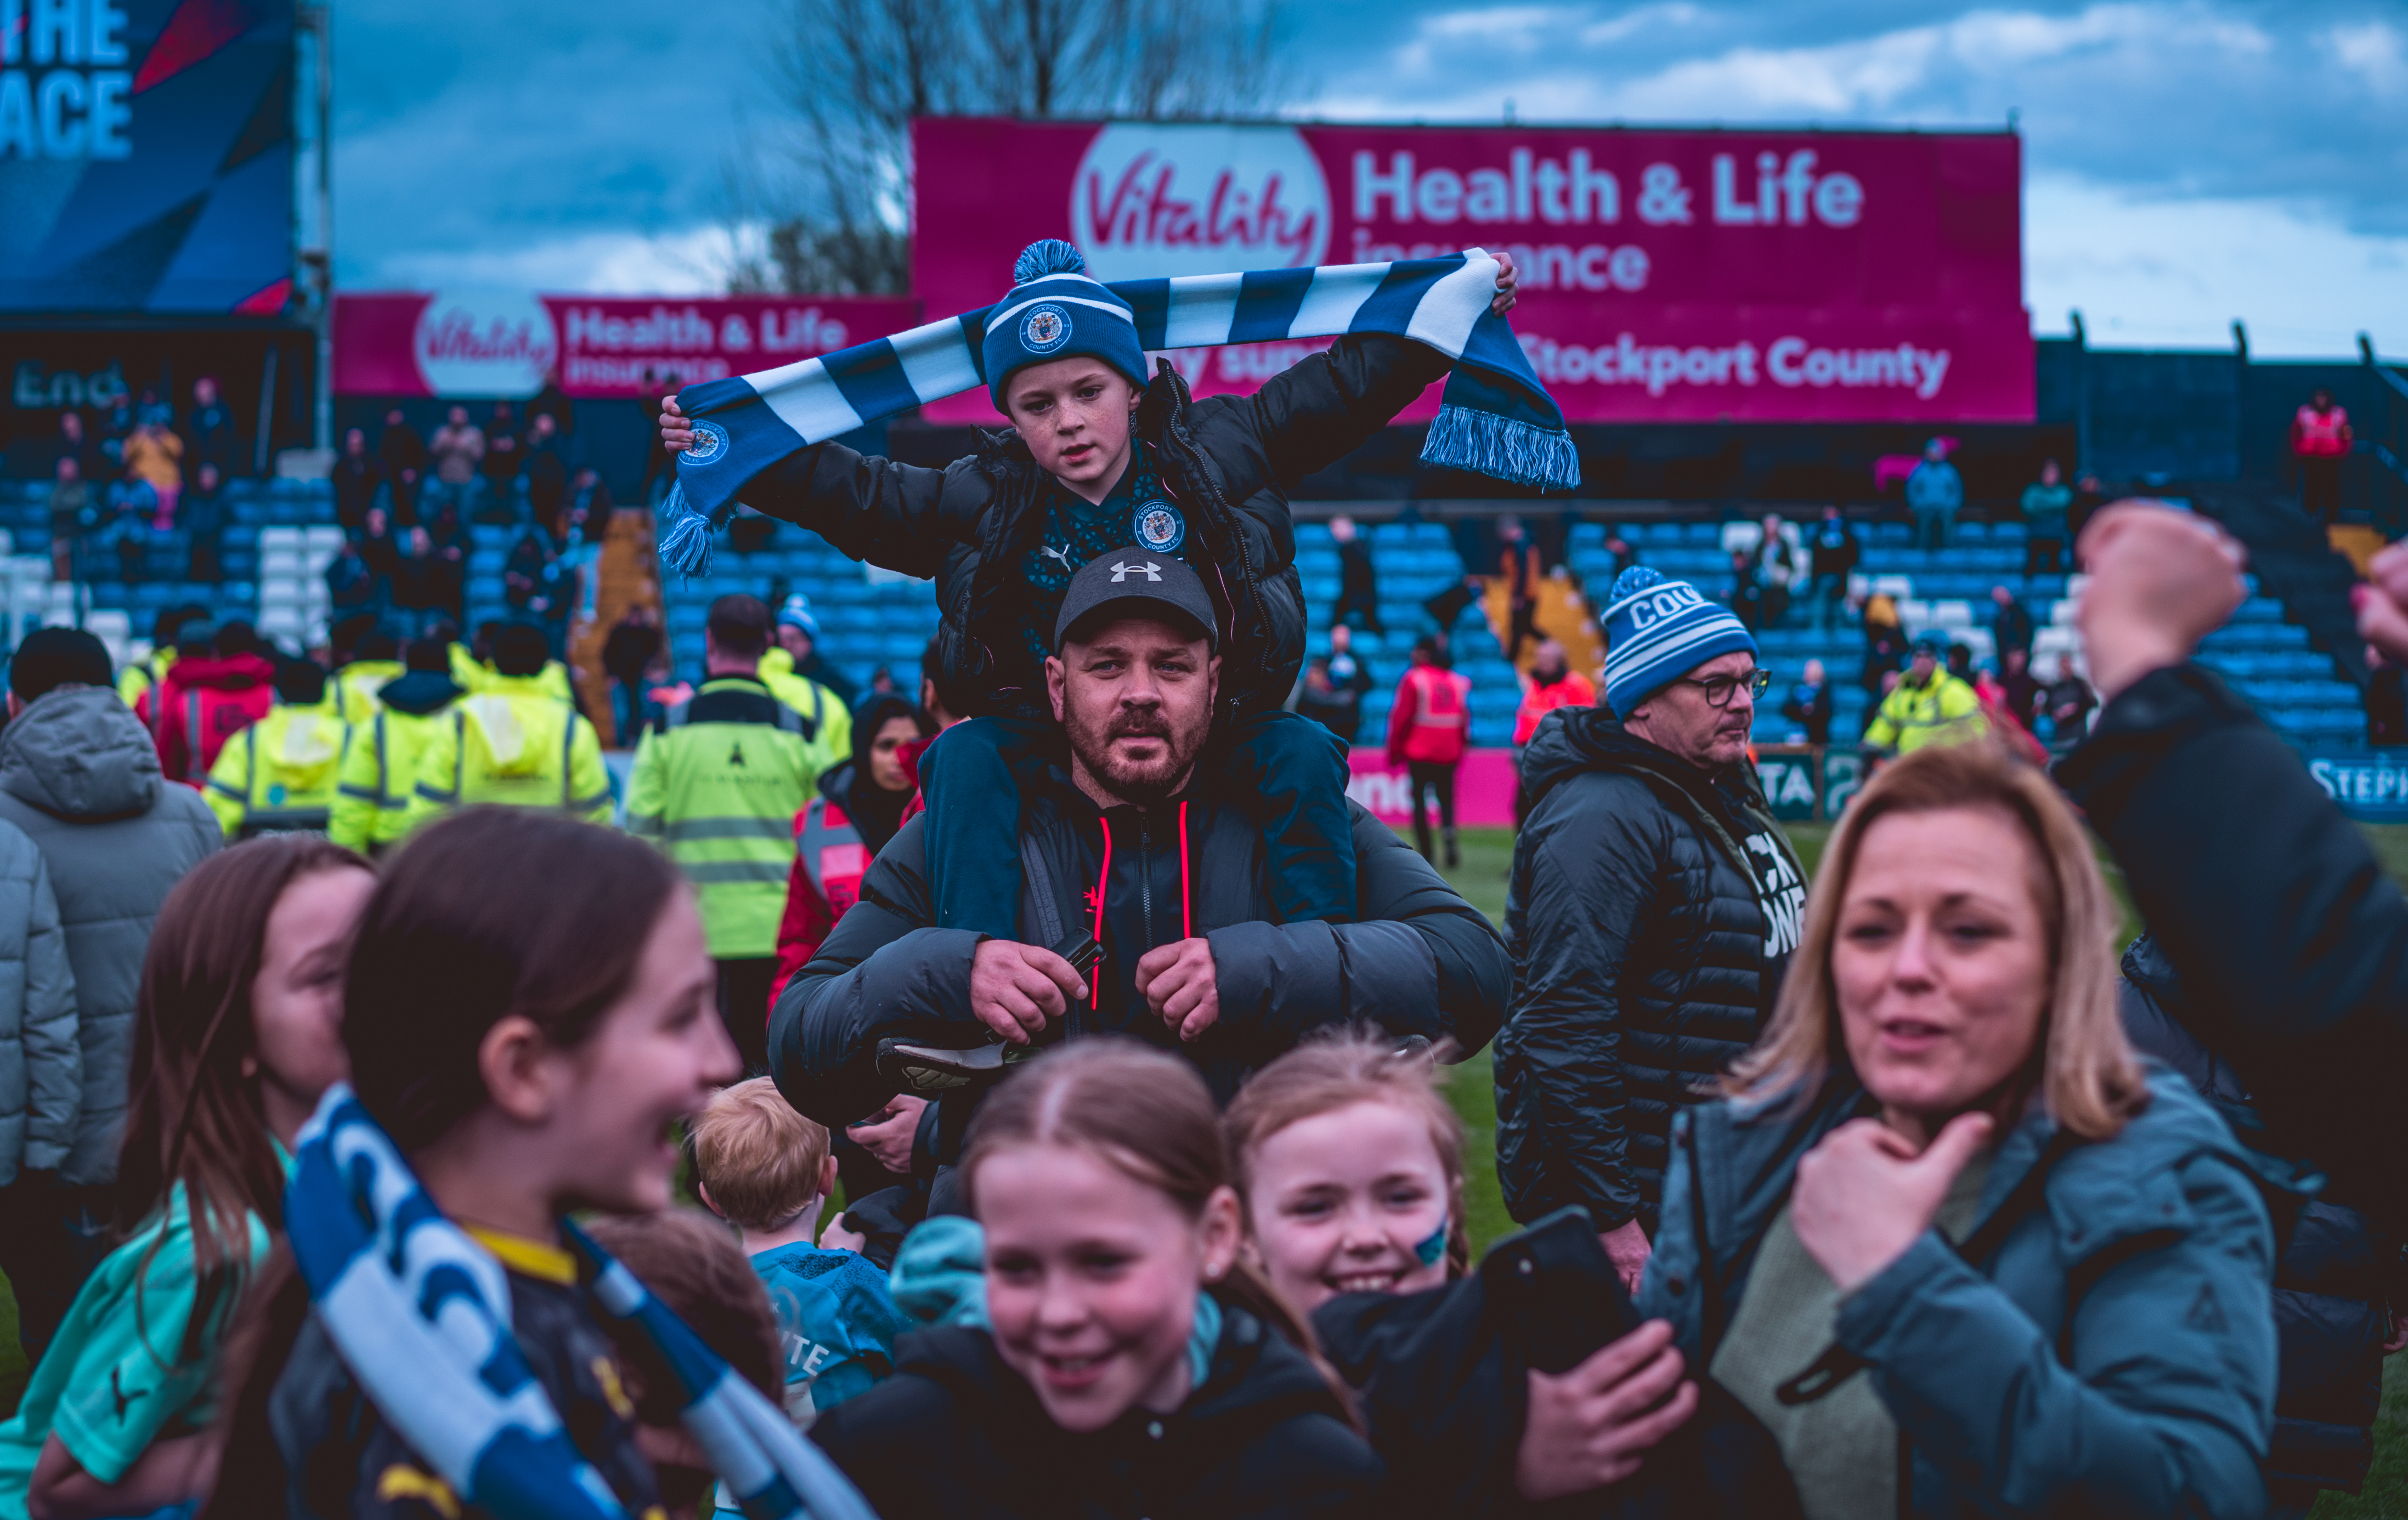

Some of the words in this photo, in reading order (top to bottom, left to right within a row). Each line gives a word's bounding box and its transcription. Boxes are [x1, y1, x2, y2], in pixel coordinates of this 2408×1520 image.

[1351, 147, 1621, 223] Health
[1636, 162, 1694, 225] &
[1711, 148, 1864, 228] Life
[1088, 148, 1318, 270] Vitality
[566, 307, 714, 351] Health
[721, 314, 753, 351] &
[761, 307, 848, 351] Life
[1026, 307, 1063, 321] STOCKPORT
[1766, 337, 1951, 399] County
[696, 422, 726, 446] STOCKPORT
[1139, 504, 1173, 520] STOCKPORT
[1172, 536, 1179, 544] FC
